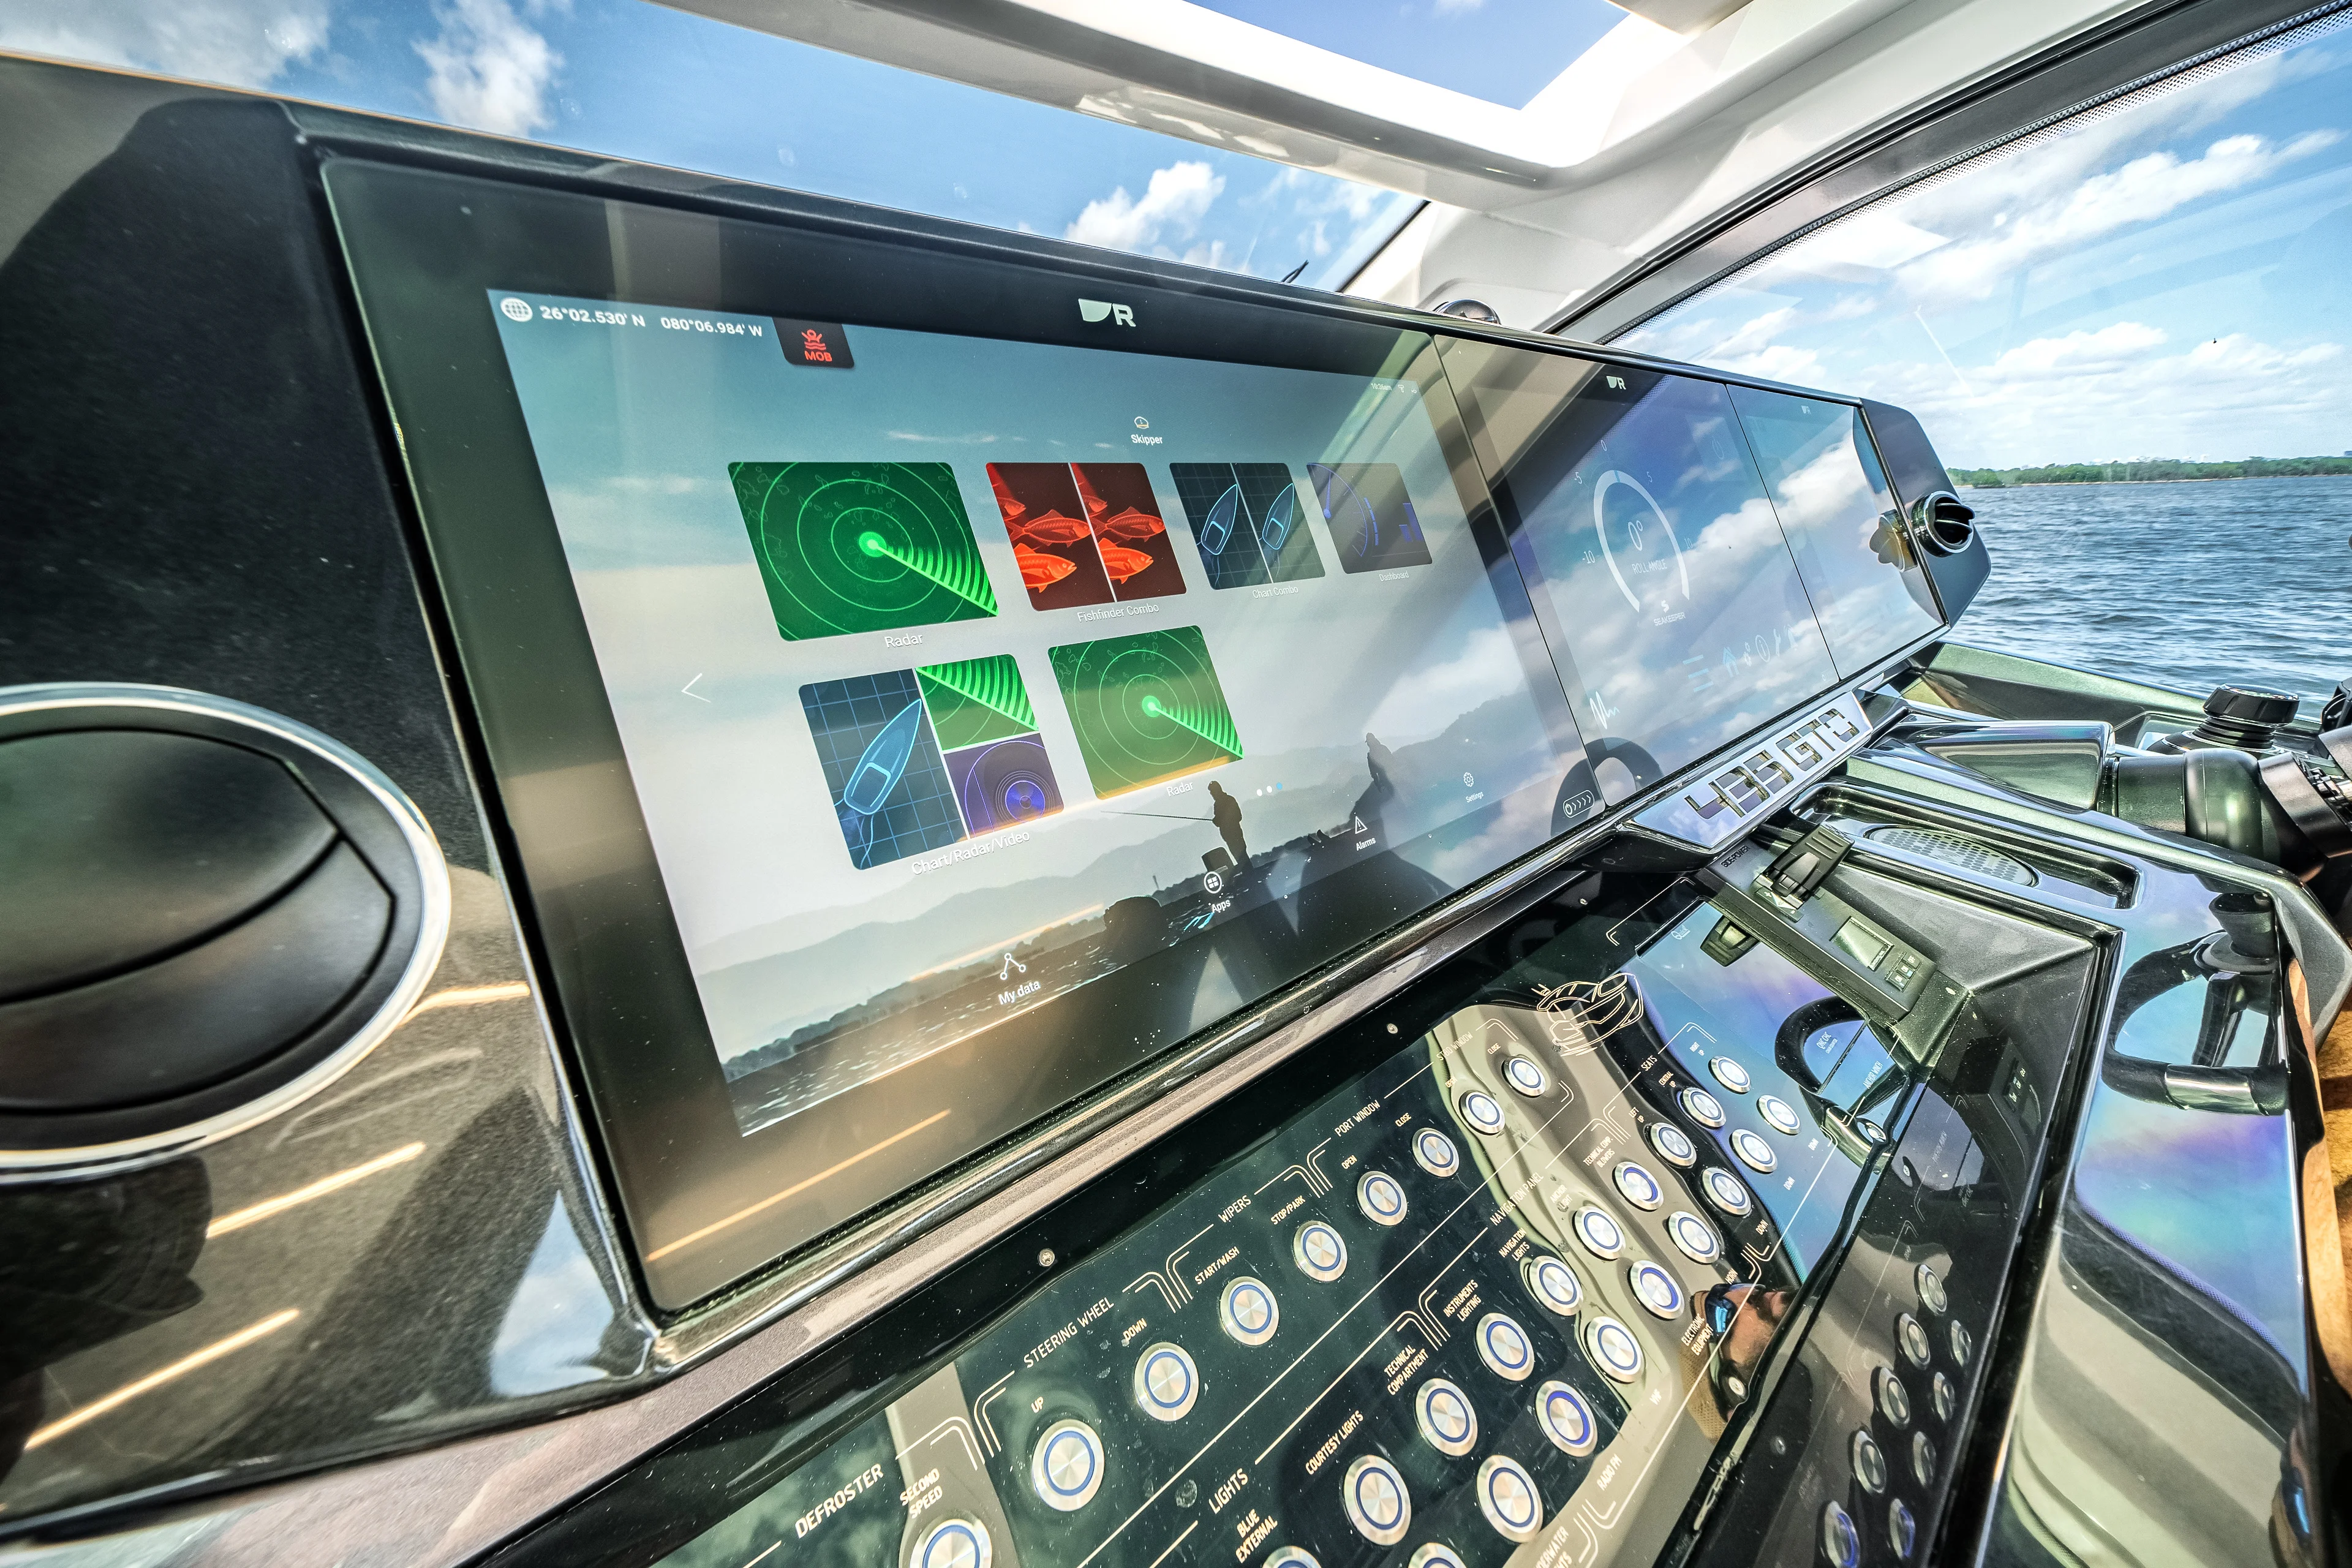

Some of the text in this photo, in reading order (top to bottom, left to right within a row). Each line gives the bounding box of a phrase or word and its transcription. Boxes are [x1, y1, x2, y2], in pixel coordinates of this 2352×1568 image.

[633, 314, 646, 327] N
[748, 326, 763, 337] W
[805, 350, 832, 363] MOB
[1131, 434, 1163, 446] Skipper
[1646, 471, 1653, 483] 5
[1379, 570, 1409, 582] Dashboard
[1632, 559, 1668, 575] ROLL ANGLE
[1252, 586, 1298, 599] Chart Combo
[1077, 603, 1159, 623] Fishfinder Combo
[1654, 612, 1686, 626] SEAKEEPER
[884, 633, 924, 649] Radar
[1166, 780, 1194, 798] Radar
[1466, 791, 1484, 803] Settings
[911, 829, 1030, 876] Chart/Radar/Video
[1355, 836, 1376, 851] Alarms
[1211, 898, 1231, 914] Apps
[998, 979, 1041, 1005] My data
[1436, 1031, 1473, 1061] STBD WINDOW
[1487, 1042, 1501, 1055] CLOSE
[1640, 1055, 1657, 1071] SEATS
[1445, 1076, 1458, 1088] OPEN
[1659, 1071, 1674, 1086] CENTRAL
[1863, 1060, 1883, 1090] ANCHOR WINCH
[1335, 1099, 1381, 1137] PORT WINDOW
[1395, 1112, 1412, 1127] CLOSE
[1628, 1106, 1640, 1118] LEFT
[1637, 1115, 1645, 1123] UP
[1583, 1136, 1613, 1166] TECHNICAL COMP.
[1807, 1137, 1819, 1151] DOWN
[1341, 1155, 1357, 1169] OPEN
[1596, 1148, 1616, 1168] BLOWERS
[1783, 1176, 1795, 1191] DOWN
[1490, 1172, 1544, 1226] NAVIGATION PANEL
[1550, 1184, 1567, 1204] ANCHOR
[1559, 1194, 1573, 1210] LIGHT
[1218, 1194, 1251, 1223] WIPERS
[1270, 1195, 1306, 1225] STOP/PARK
[1755, 1219, 1768, 1235] DOWN
[1498, 1227, 1527, 1258] NAVIGATION
[1511, 1241, 1530, 1262] LIGHTS
[1194, 1246, 1240, 1284] START/WASH
[1725, 1268, 1738, 1285] HORN
[1443, 1279, 1479, 1317] INSTRUMENTS
[1457, 1294, 1482, 1322] LIGHTING
[1023, 1297, 1115, 1368] STEERING WHEEL
[1123, 1317, 1147, 1341] DOWN
[1681, 1313, 1705, 1347] ELECTRONIC
[1691, 1323, 1714, 1356] EQUIPMENT
[1384, 1344, 1416, 1378] TECHNICAL
[1387, 1348, 1429, 1396] COMPARTMENT
[1031, 1396, 1044, 1413] UP
[1649, 1388, 1662, 1405] VHF
[1305, 1410, 1364, 1475] COURTESY LIGHTS
[1596, 1453, 1622, 1491] RADIO FM
[899, 1468, 940, 1506] SECOND
[1208, 1468, 1248, 1514] LIGHTS
[794, 1463, 884, 1539] DEFROSTER
[909, 1485, 943, 1519] SPEED
[1237, 1509, 1260, 1538] BLUE
[1235, 1515, 1278, 1564] EXTERNAL
